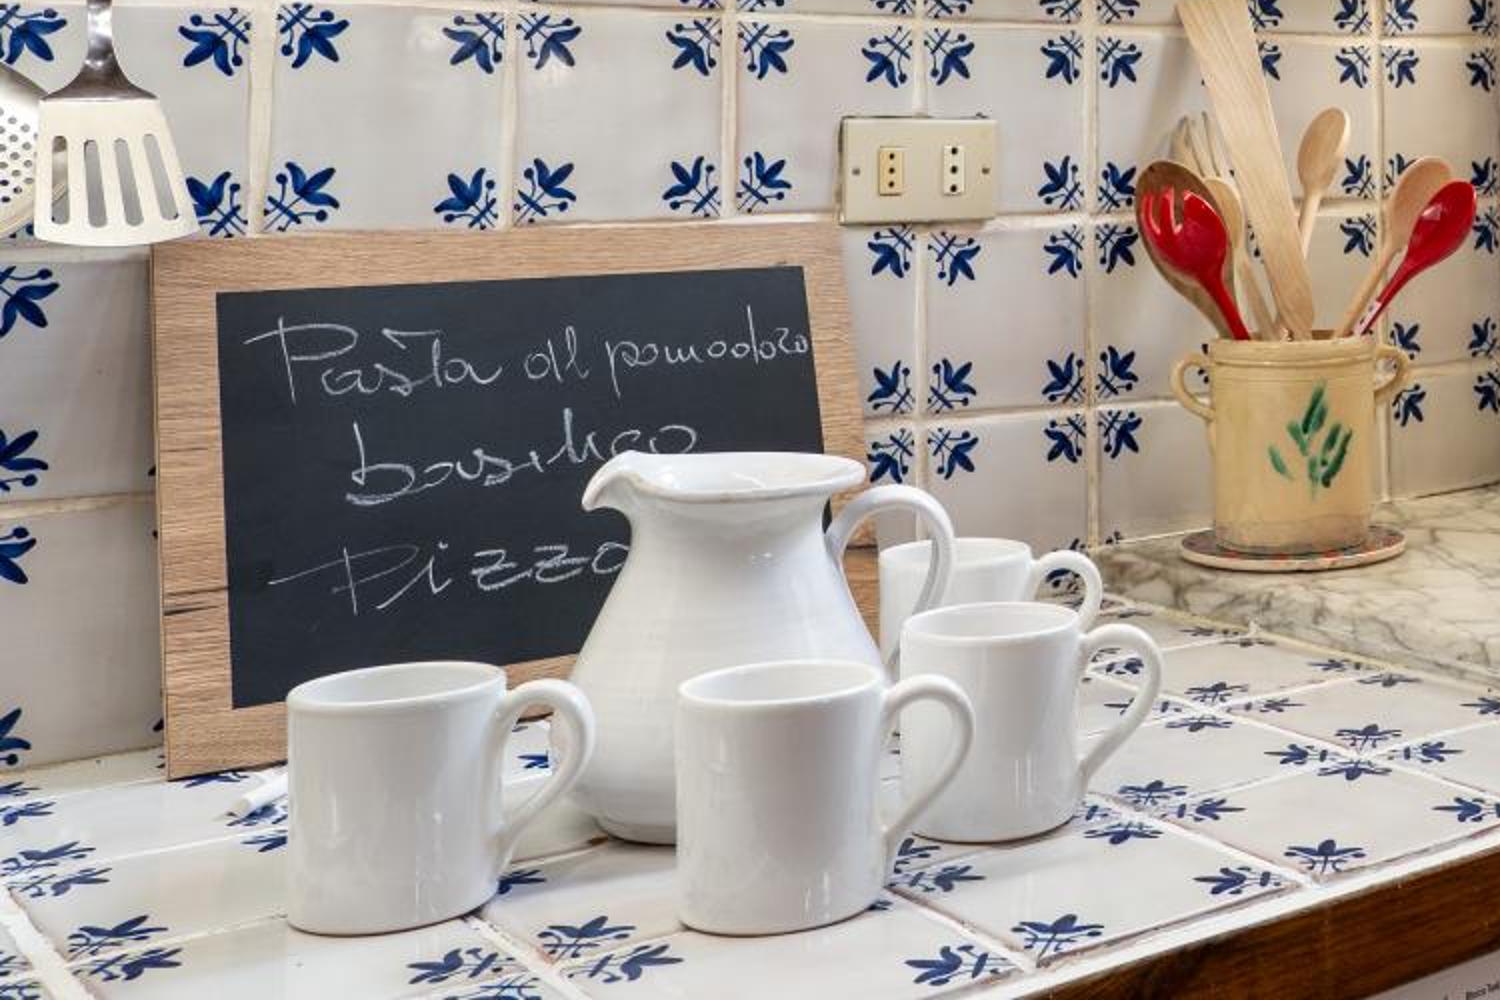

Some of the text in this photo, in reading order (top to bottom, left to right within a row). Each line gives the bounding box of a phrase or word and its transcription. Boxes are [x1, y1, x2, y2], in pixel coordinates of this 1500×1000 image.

[243, 304, 810, 403] Pasta al pomodoro
